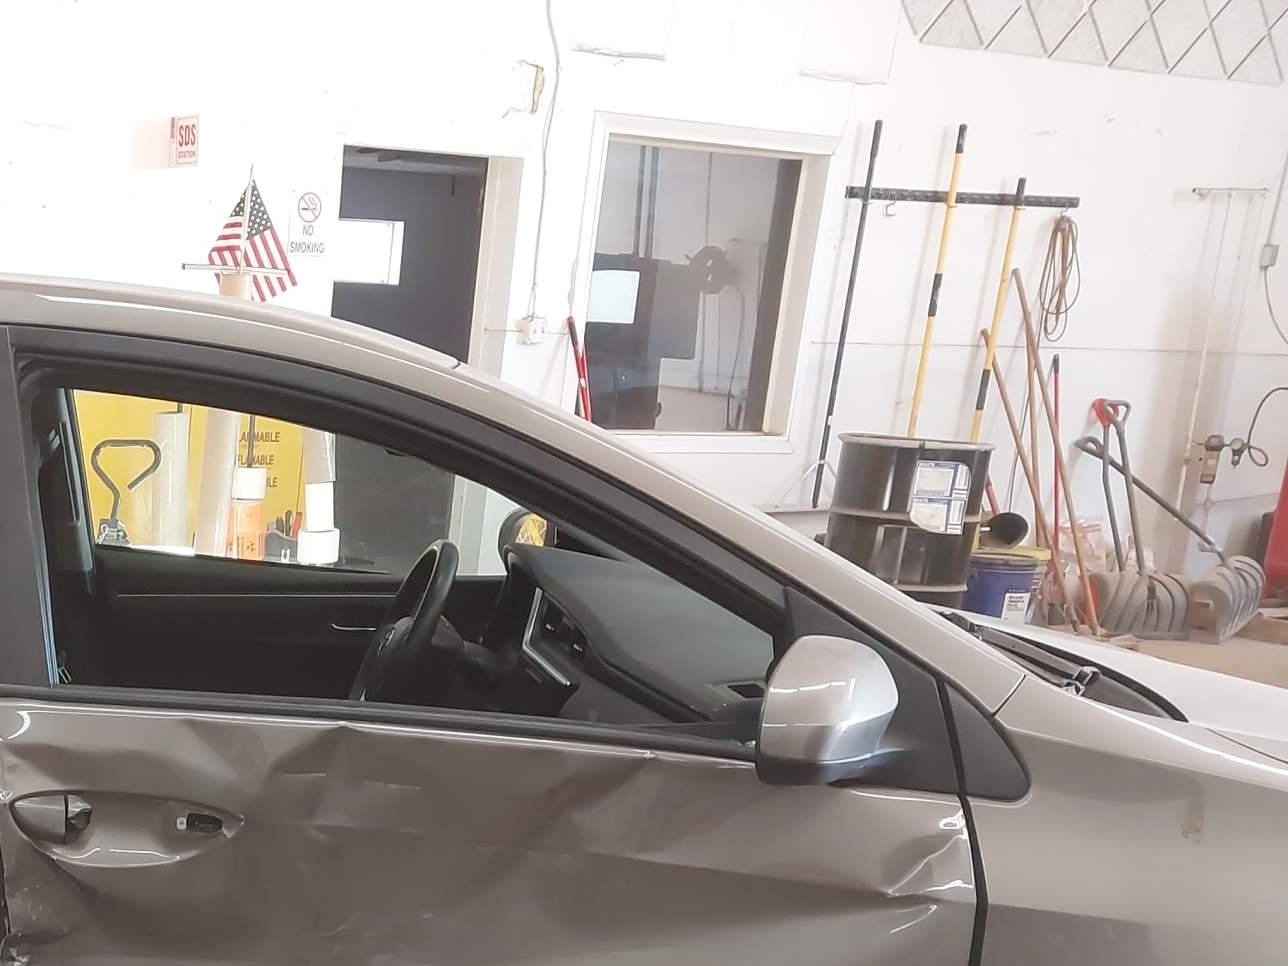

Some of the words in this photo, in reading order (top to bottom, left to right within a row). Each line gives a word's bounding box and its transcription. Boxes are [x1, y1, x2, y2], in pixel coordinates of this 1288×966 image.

[178, 123, 197, 147] SDS
[302, 223, 314, 237] NO
[289, 240, 325, 254] SMOKING
